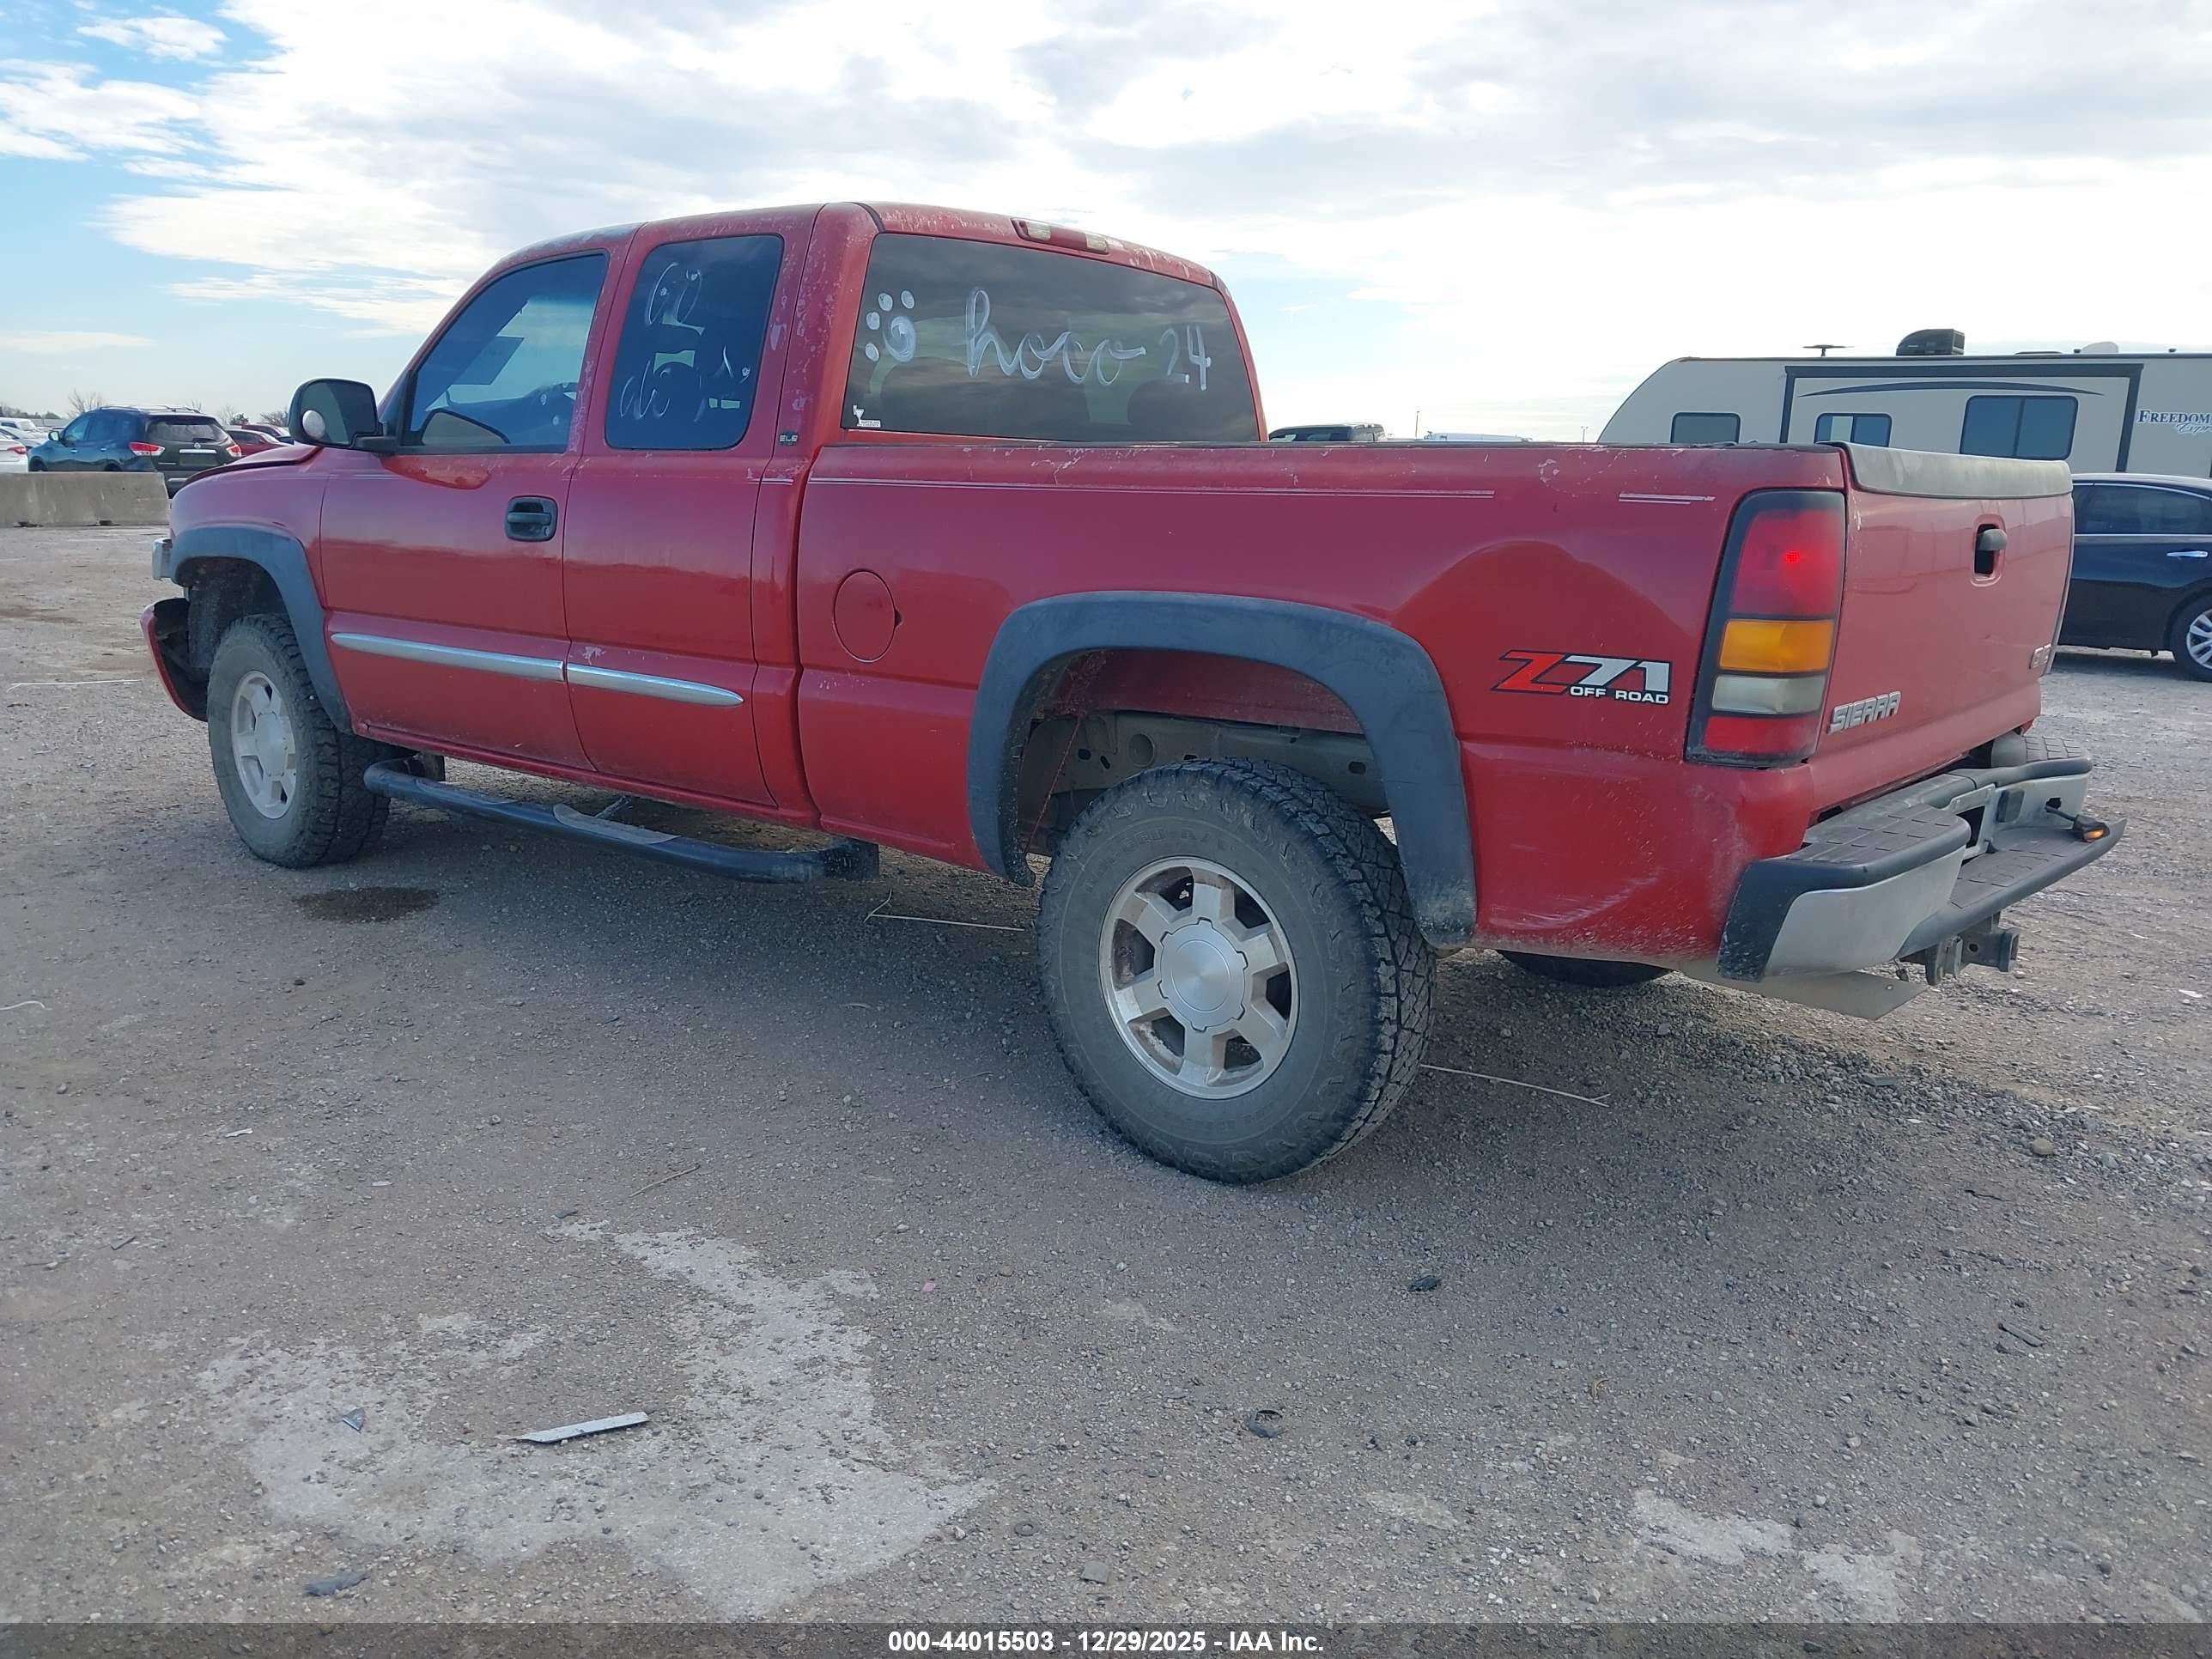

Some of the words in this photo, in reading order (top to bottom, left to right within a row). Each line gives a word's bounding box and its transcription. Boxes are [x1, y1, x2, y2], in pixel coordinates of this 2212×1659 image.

[1158, 323, 1212, 391] 24
[1491, 650, 1672, 695] Z71
[1570, 685, 1607, 698] OFF
[1615, 690, 1669, 705] ROAD
[1828, 690, 1901, 735] SIERRA
